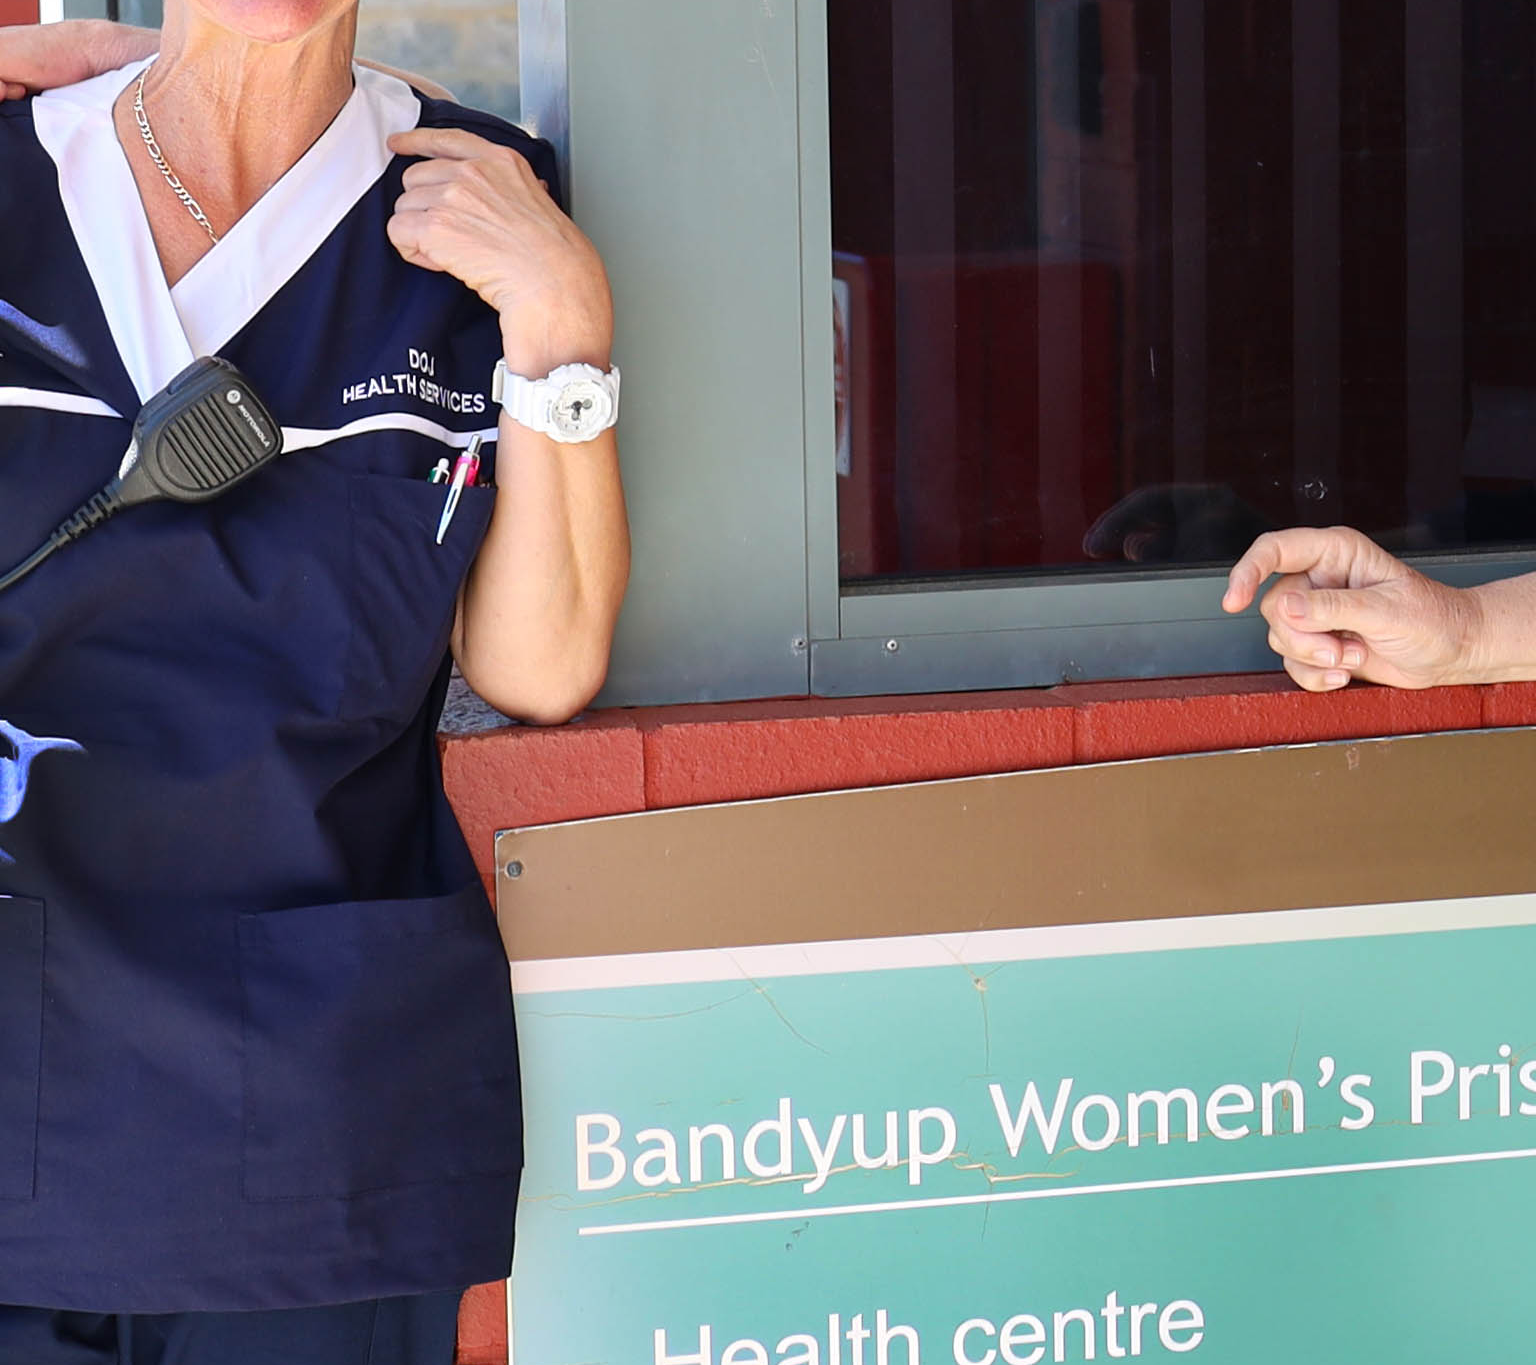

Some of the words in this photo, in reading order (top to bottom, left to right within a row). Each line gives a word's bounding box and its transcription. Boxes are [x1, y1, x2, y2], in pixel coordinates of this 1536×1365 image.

[408, 347, 435, 377] DOJ
[342, 374, 417, 405] HEALTH
[419, 377, 486, 414] SERVICES
[238, 404, 271, 448] MOTOROLA
[575, 1094, 958, 1195] Bandyup
[987, 1054, 1375, 1152] Women's
